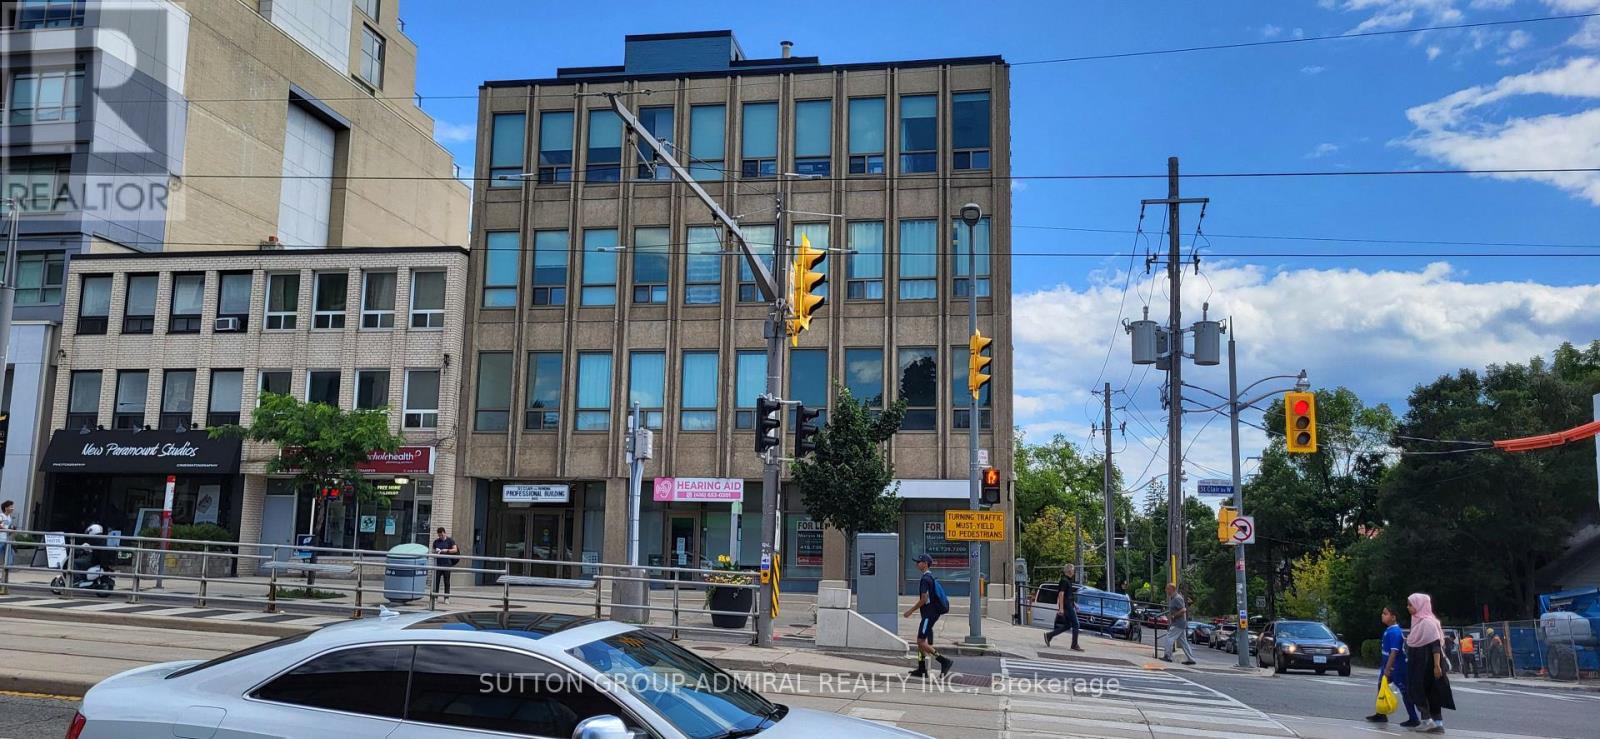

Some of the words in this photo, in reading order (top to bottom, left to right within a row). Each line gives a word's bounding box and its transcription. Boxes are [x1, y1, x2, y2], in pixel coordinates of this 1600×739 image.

[82, 443, 103, 456] New
[106, 443, 159, 456] Paramount
[157, 441, 200, 457] Studios
[677, 481, 721, 489] HEARING
[724, 482, 741, 490] AID
[948, 513, 974, 521] TURNING
[926, 523, 942, 531] FOR
